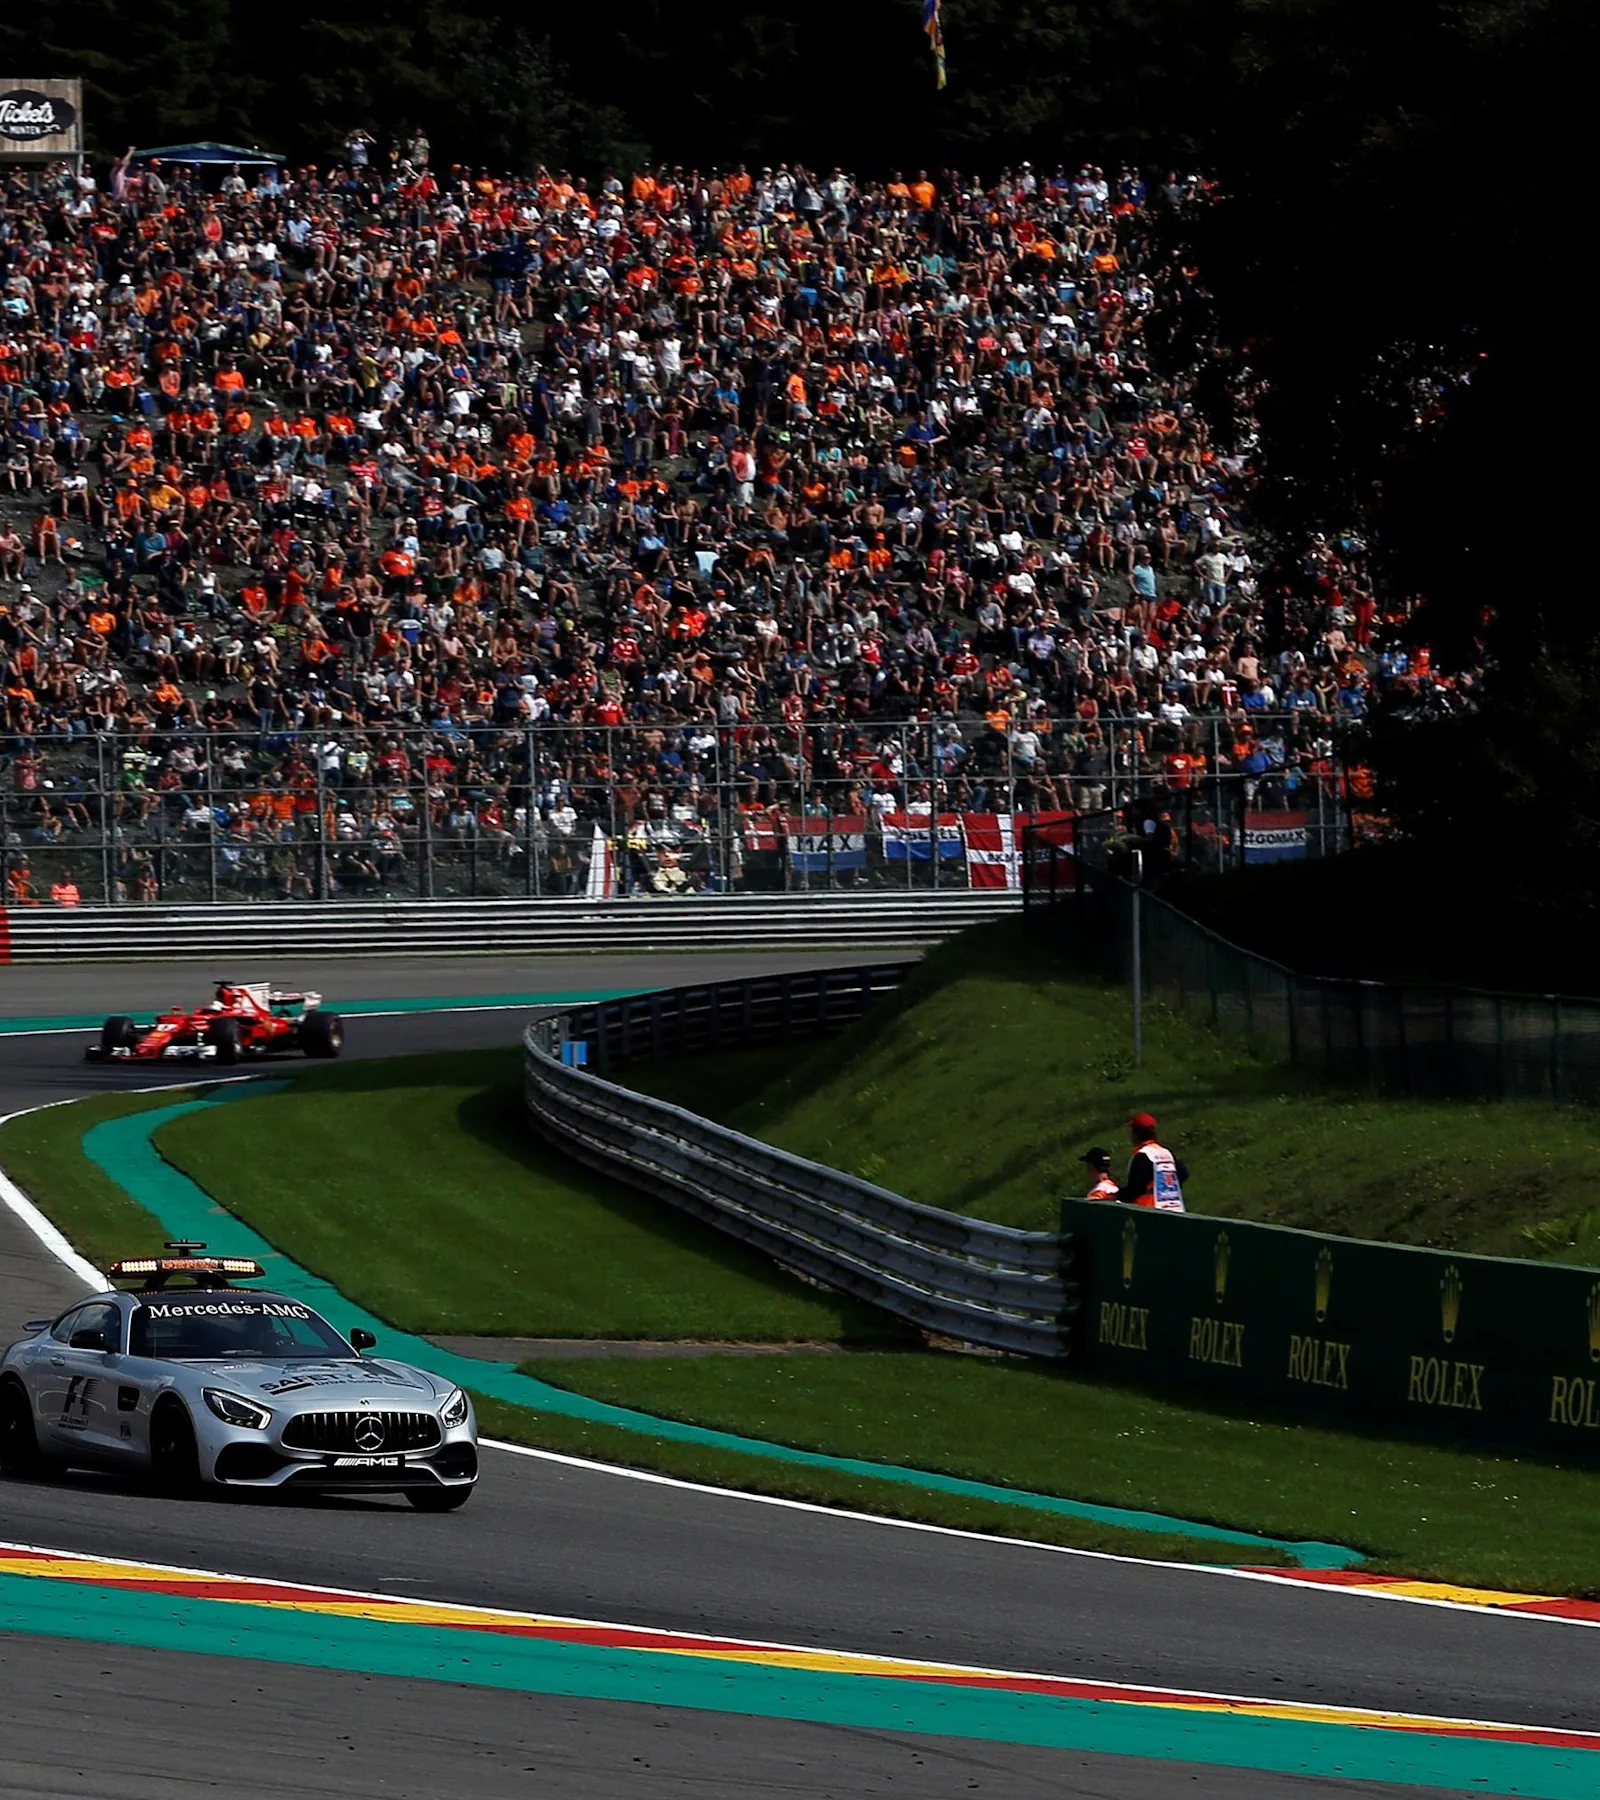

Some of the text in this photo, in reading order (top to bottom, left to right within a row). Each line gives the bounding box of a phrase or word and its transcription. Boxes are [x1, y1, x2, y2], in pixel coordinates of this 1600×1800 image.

[797, 834, 851, 852] MAX
[148, 1301, 310, 1320] Mercedes-AMG
[1101, 1303, 1148, 1350] ROLEX
[1188, 1318, 1245, 1367] ROLEX
[1287, 1336, 1350, 1389] ROLEX
[1408, 1356, 1484, 1410] ROLEX
[1548, 1375, 1600, 1427] ROL
[355, 1457, 399, 1467] AMG
